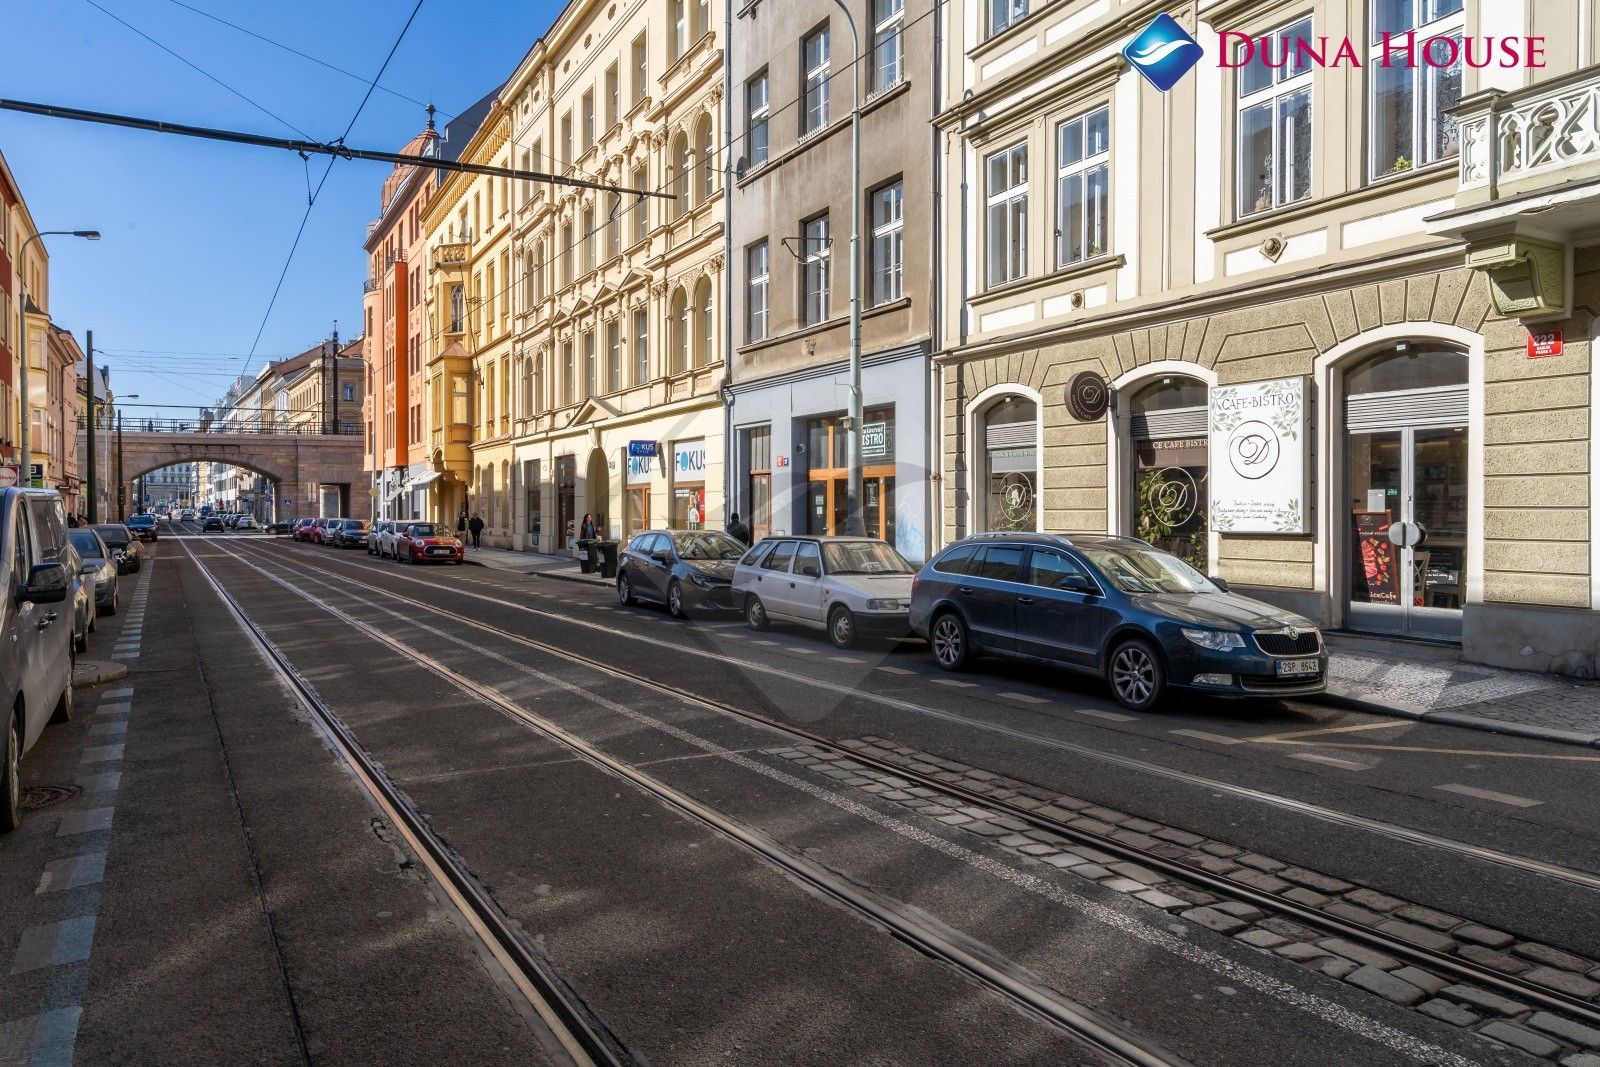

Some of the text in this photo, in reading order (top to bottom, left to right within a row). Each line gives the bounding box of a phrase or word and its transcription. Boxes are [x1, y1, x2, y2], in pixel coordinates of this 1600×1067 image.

[1533, 334, 1555, 347] 222
[862, 432, 884, 446] ISTRO
[1164, 440, 1185, 449] CAFE
[1185, 438, 1208, 448] BISTR
[631, 443, 654, 451] FOKUS
[627, 456, 652, 475] FOKU
